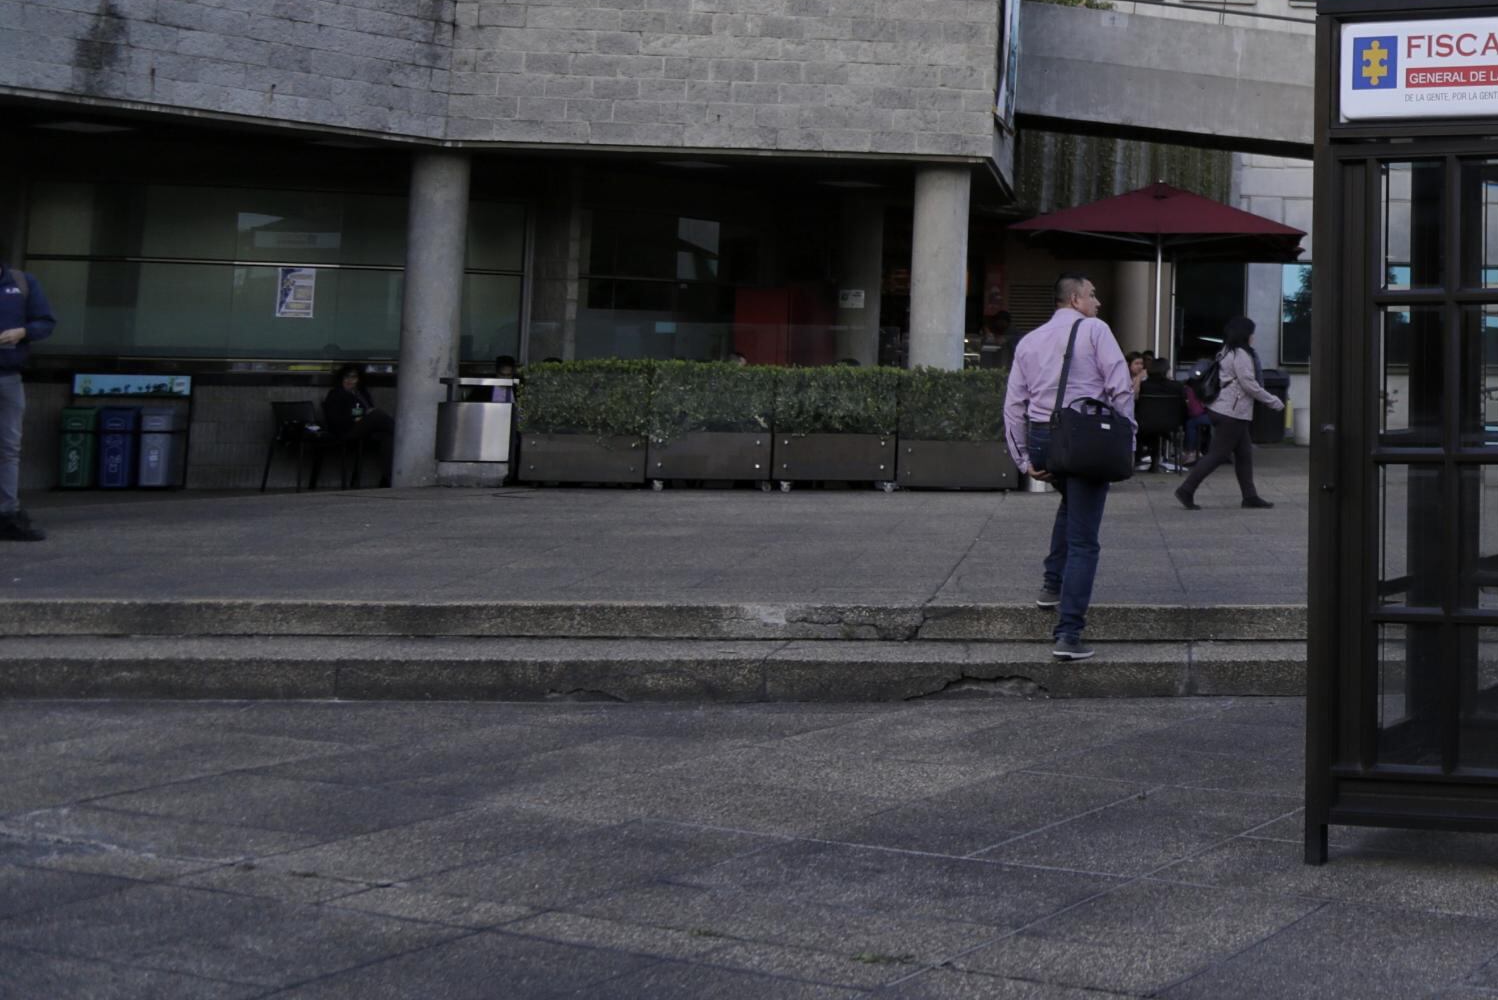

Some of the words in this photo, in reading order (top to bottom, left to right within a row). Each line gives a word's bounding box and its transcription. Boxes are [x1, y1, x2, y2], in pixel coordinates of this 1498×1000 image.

[1409, 71, 1468, 84] GENERAL
[1469, 71, 1487, 82] DE
[1404, 93, 1415, 102] DE
[1416, 93, 1425, 102] LA
[1452, 91, 1467, 101] POR
[1469, 91, 1478, 101] LA
